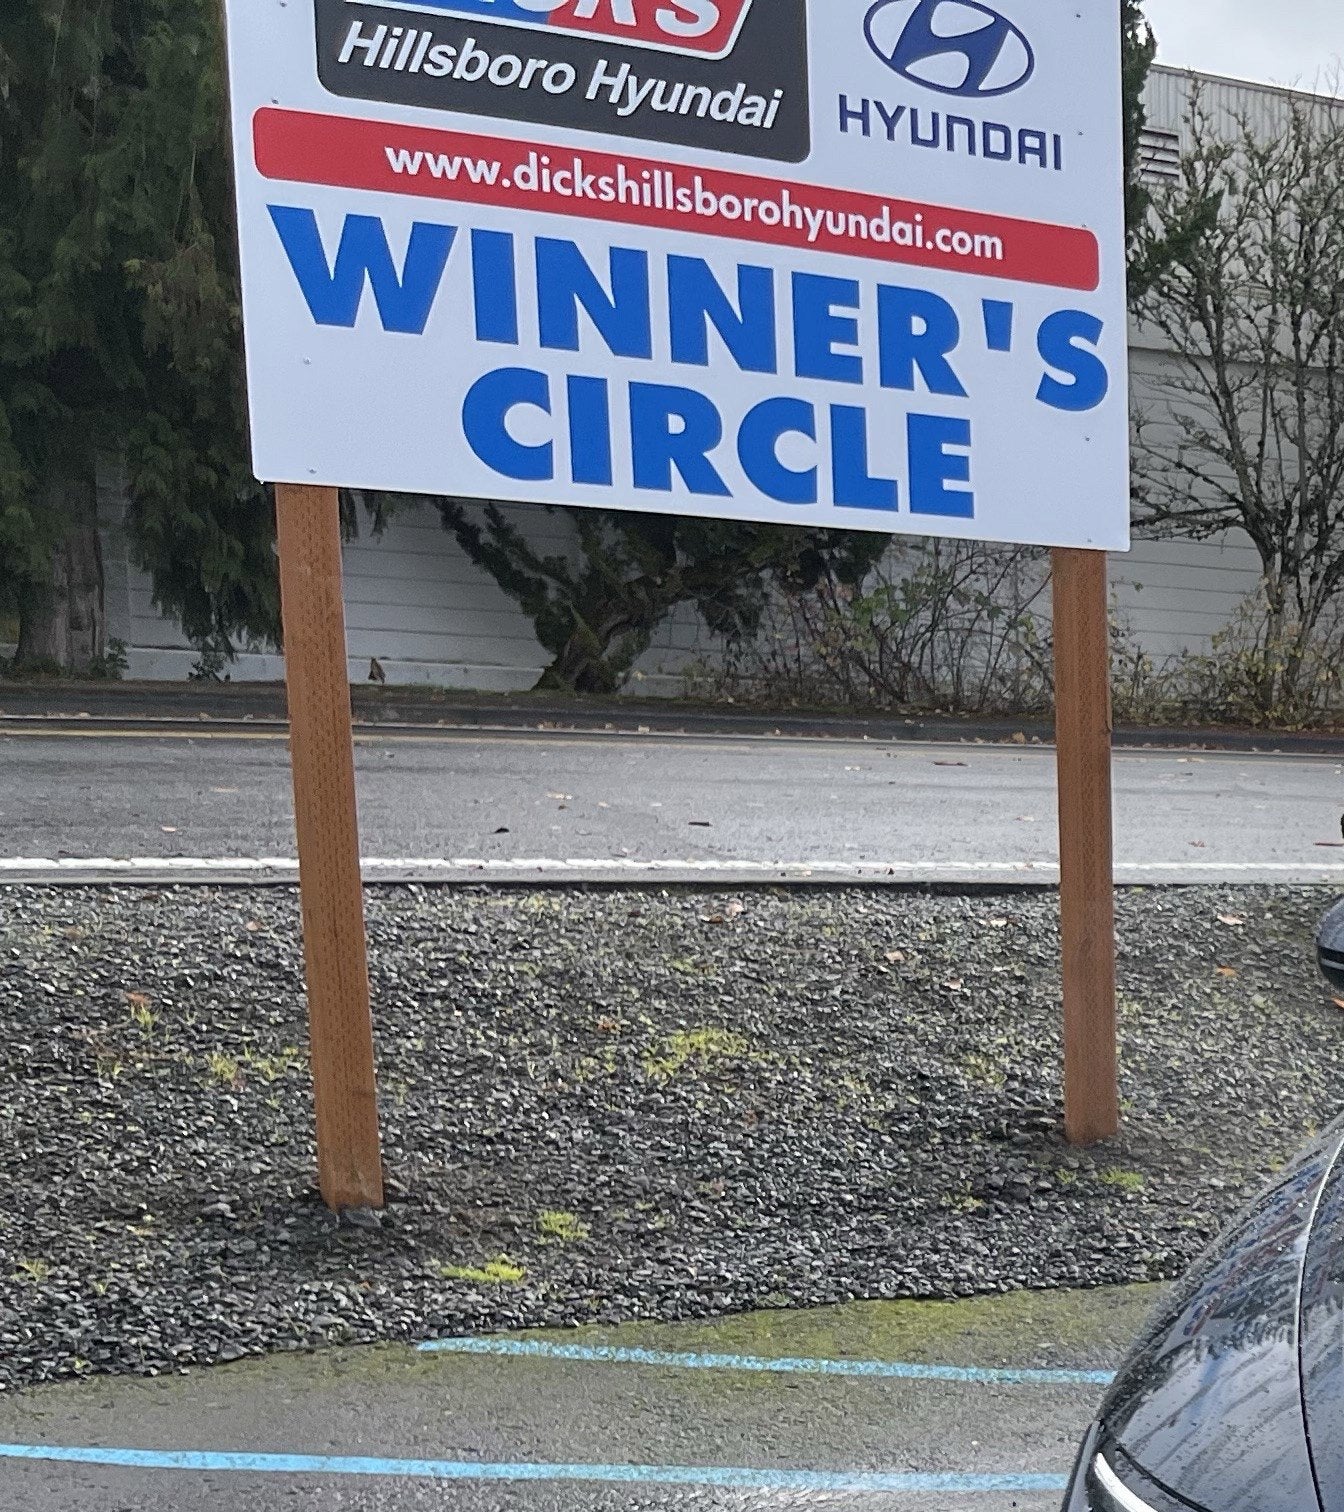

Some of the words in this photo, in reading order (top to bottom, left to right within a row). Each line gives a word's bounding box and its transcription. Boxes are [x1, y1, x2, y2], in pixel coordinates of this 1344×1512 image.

[338, 20, 576, 95] Hillsboro
[585, 59, 783, 129] Hyundai
[838, 94, 1063, 171] HYUNDAI
[385, 146, 1004, 260] www.dickshillsborohyundai.com
[266, 204, 1109, 412] WINNER'S
[462, 366, 975, 519] CIRCLE
